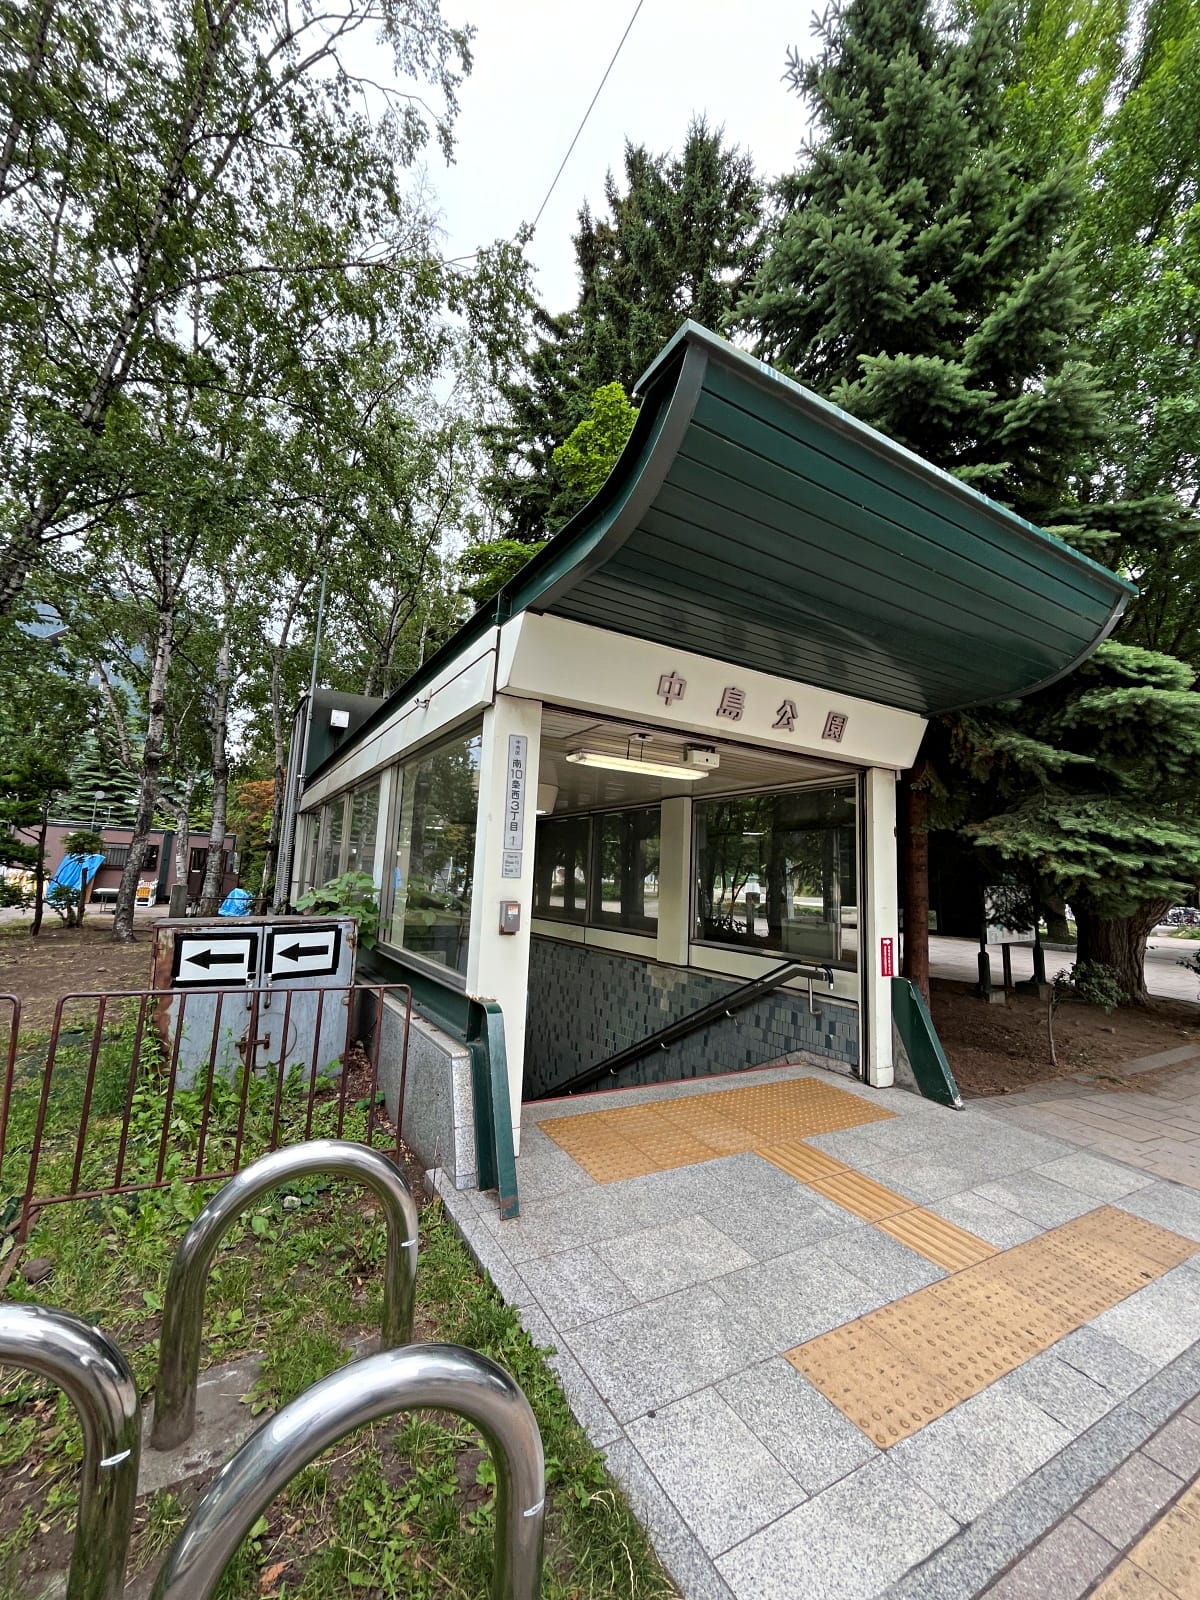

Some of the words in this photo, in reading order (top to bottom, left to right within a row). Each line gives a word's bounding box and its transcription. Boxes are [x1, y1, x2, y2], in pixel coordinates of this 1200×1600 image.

[656, 671, 849, 744] 中島公園
[510, 759, 523, 832] 南10条西3丁目
